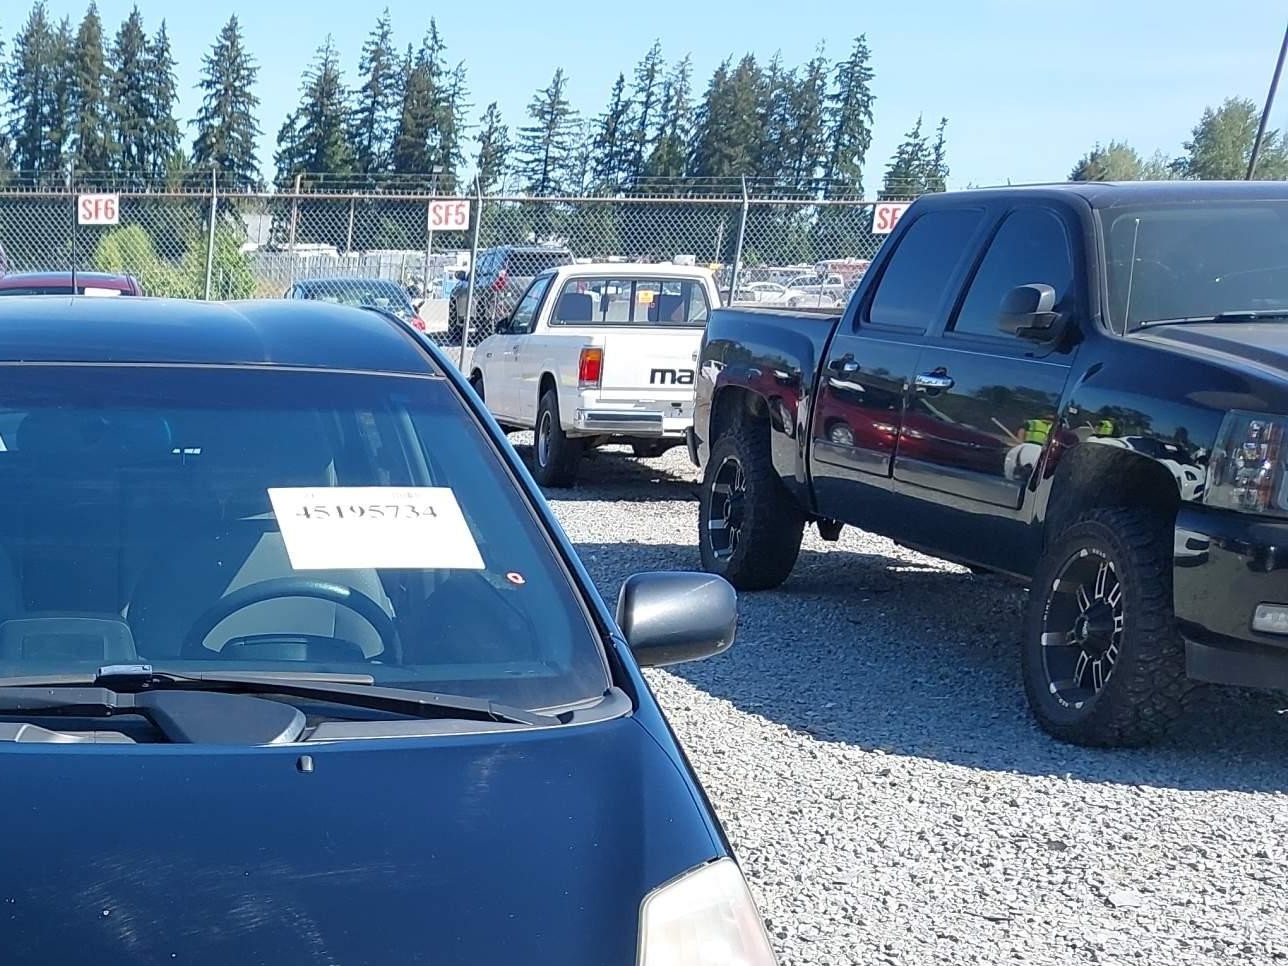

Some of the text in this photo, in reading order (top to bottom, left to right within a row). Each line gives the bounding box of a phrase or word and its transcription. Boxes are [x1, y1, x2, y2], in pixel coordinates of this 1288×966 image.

[82, 198, 116, 220] SF6
[431, 203, 466, 226] SF5
[295, 504, 439, 520] 45195734
